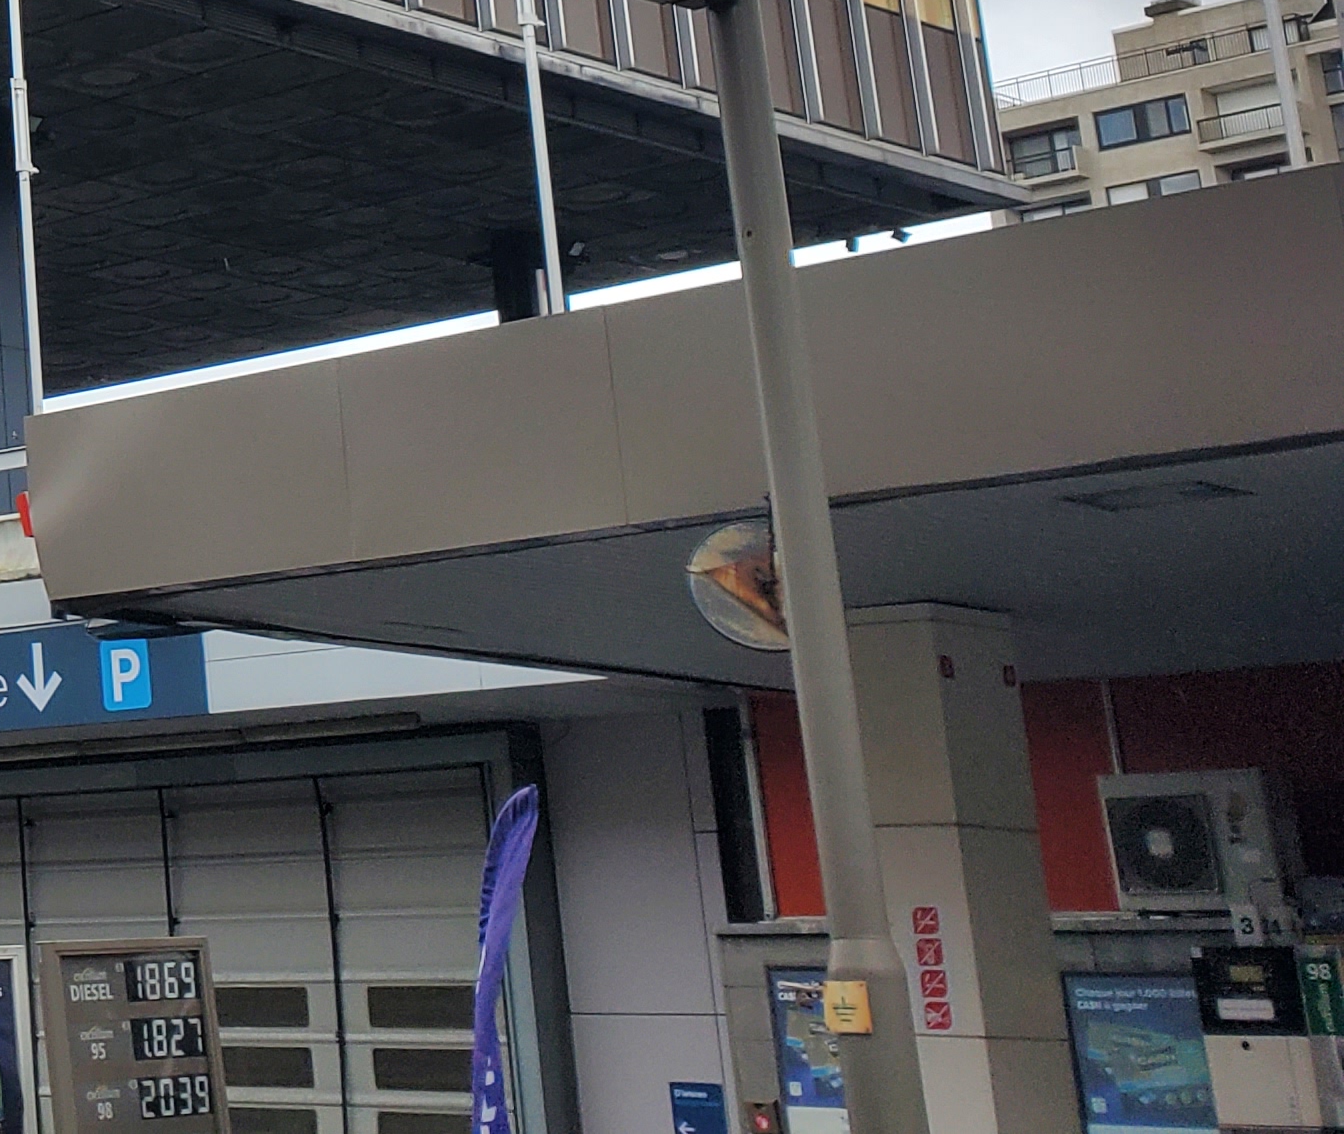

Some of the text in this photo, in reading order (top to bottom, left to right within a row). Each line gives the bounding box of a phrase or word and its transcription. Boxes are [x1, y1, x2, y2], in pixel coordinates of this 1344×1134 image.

[110, 648, 141, 702] P
[1240, 917, 1254, 935] 3
[1306, 963, 1332, 980] 98
[70, 983, 114, 1002] DIESEL
[91, 1042, 107, 1060] 95
[97, 1101, 113, 1120] 98
